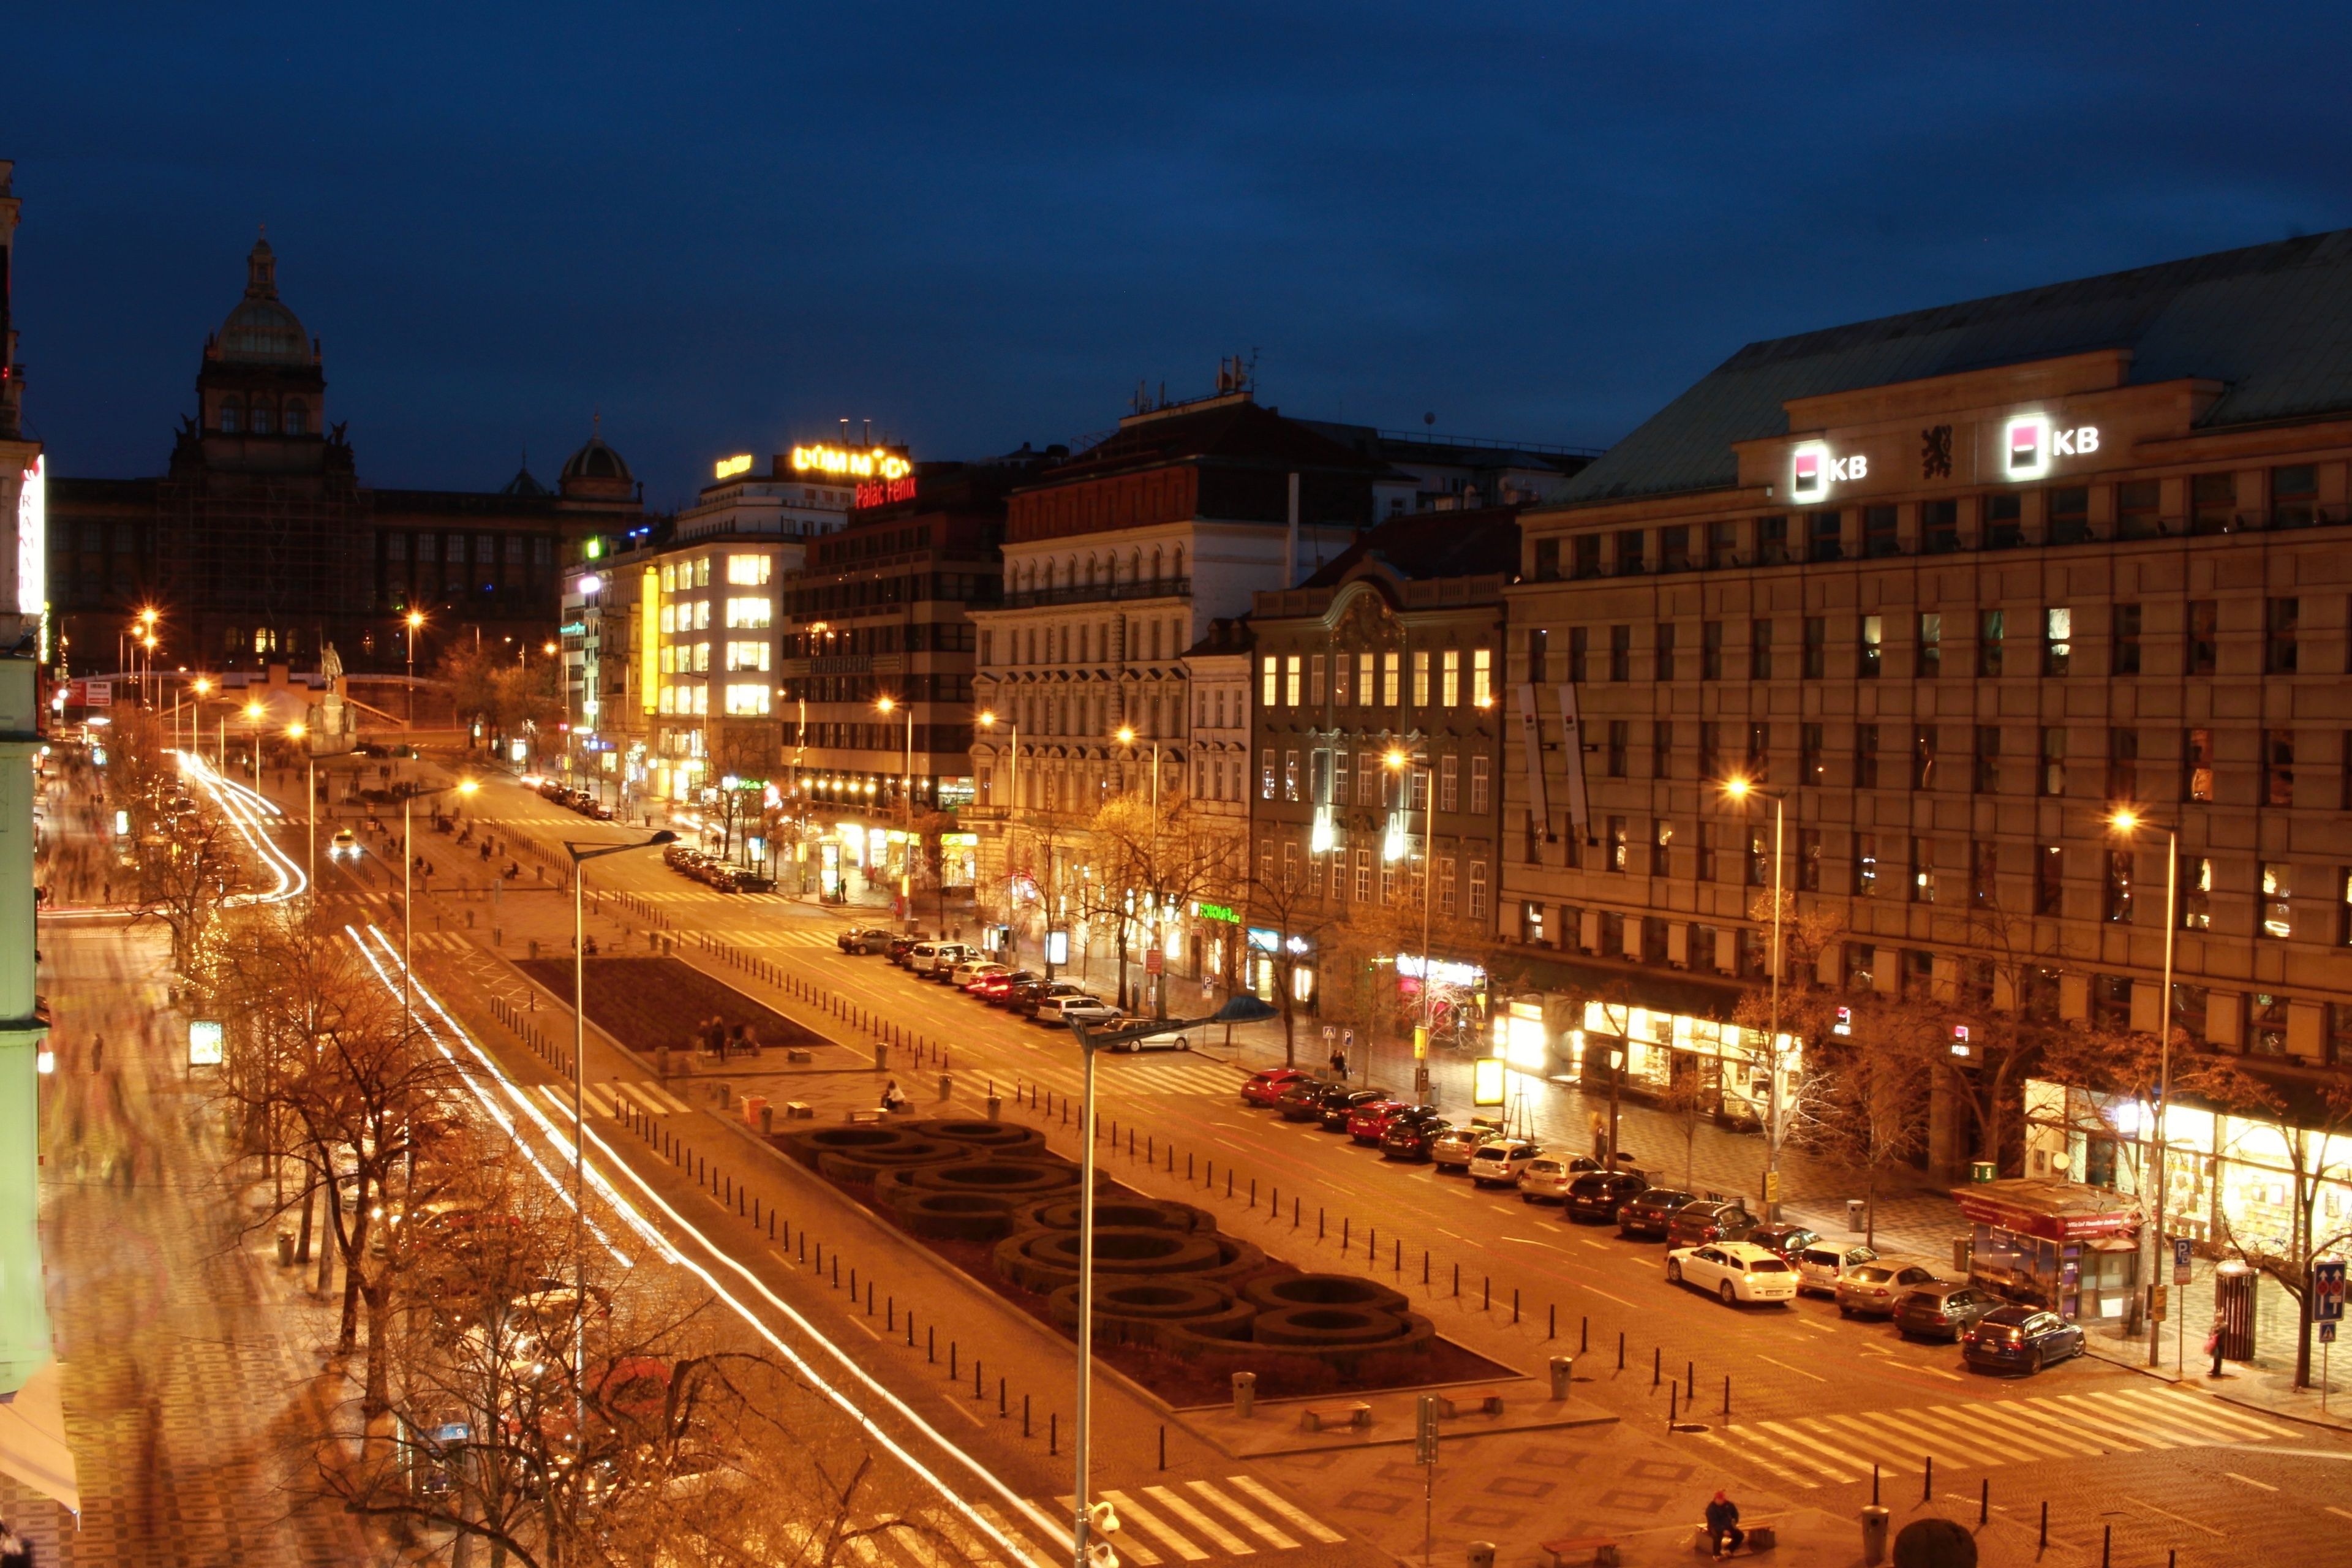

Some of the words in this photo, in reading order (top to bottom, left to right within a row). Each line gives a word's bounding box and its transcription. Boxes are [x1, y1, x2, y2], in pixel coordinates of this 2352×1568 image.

[2053, 427, 2099, 456] KB
[1830, 455, 1868, 482] KB
[856, 480, 884, 510] Palác
[20, 494, 34, 611] RAMADA
[1344, 1031, 1351, 1040] P
[2178, 1242, 2188, 1257] P
